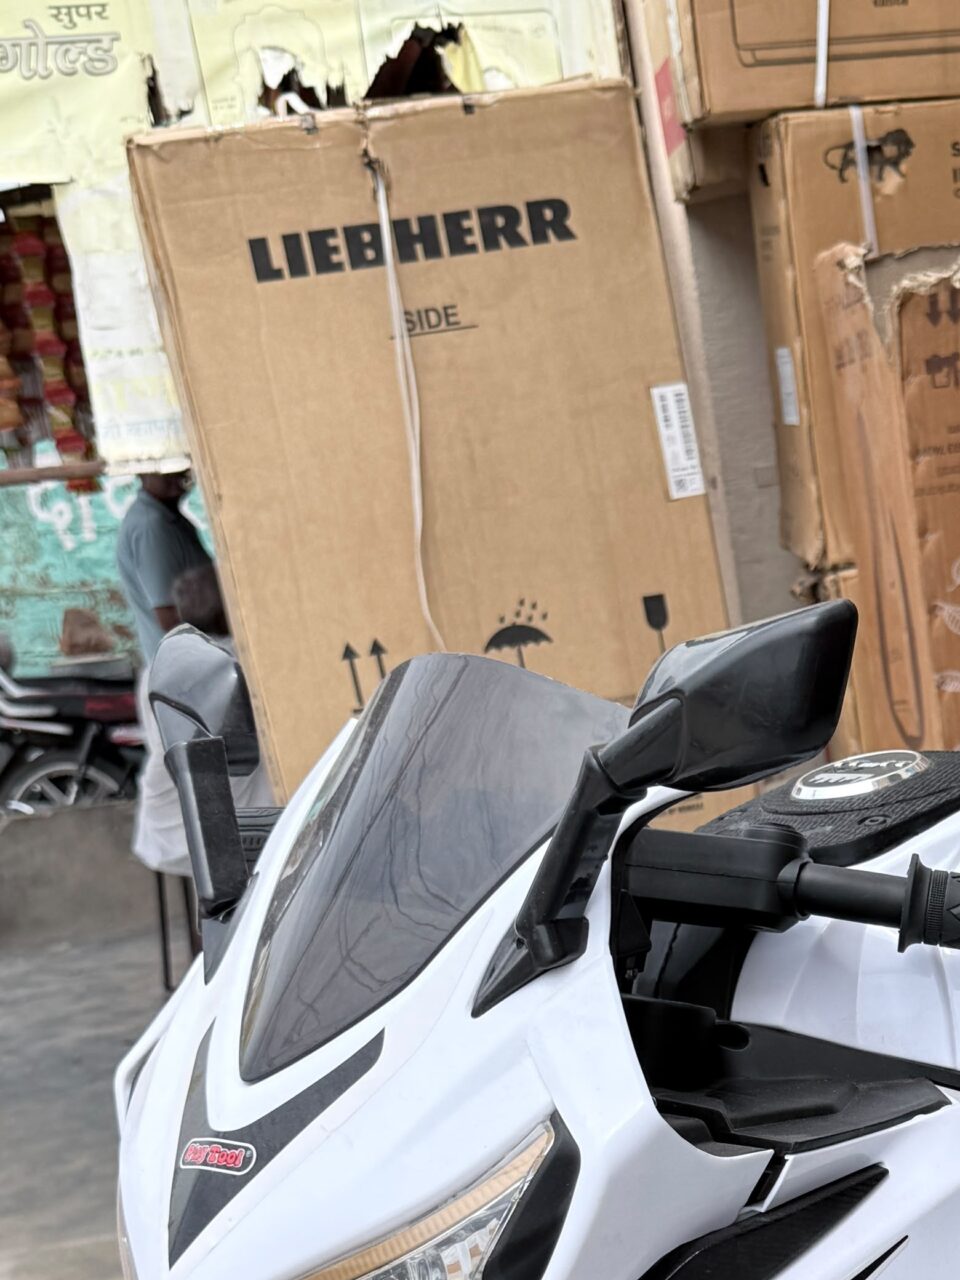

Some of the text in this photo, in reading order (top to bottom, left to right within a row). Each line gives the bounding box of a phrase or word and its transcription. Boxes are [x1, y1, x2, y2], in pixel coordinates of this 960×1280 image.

[48, 3, 110, 30] सुपर
[248, 198, 577, 283] LIEBHERR
[402, 304, 461, 333] SIDE
